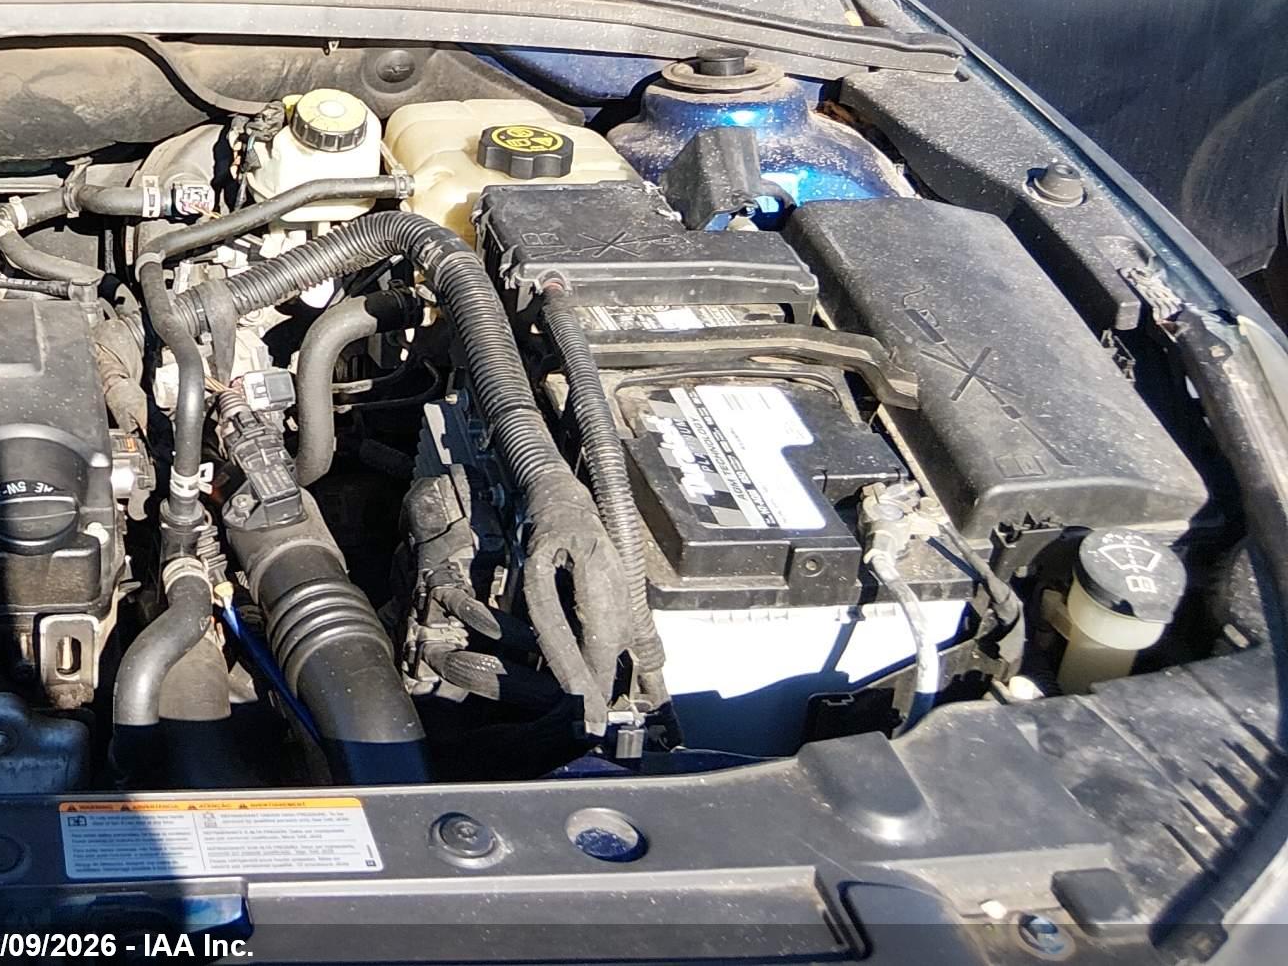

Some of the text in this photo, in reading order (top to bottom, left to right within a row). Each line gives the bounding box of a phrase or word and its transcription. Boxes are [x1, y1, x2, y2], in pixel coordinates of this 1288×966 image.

[691, 417, 732, 476] TECHNOLOGY
[34, 482, 54, 493] AE
[728, 477, 748, 502] AGM
